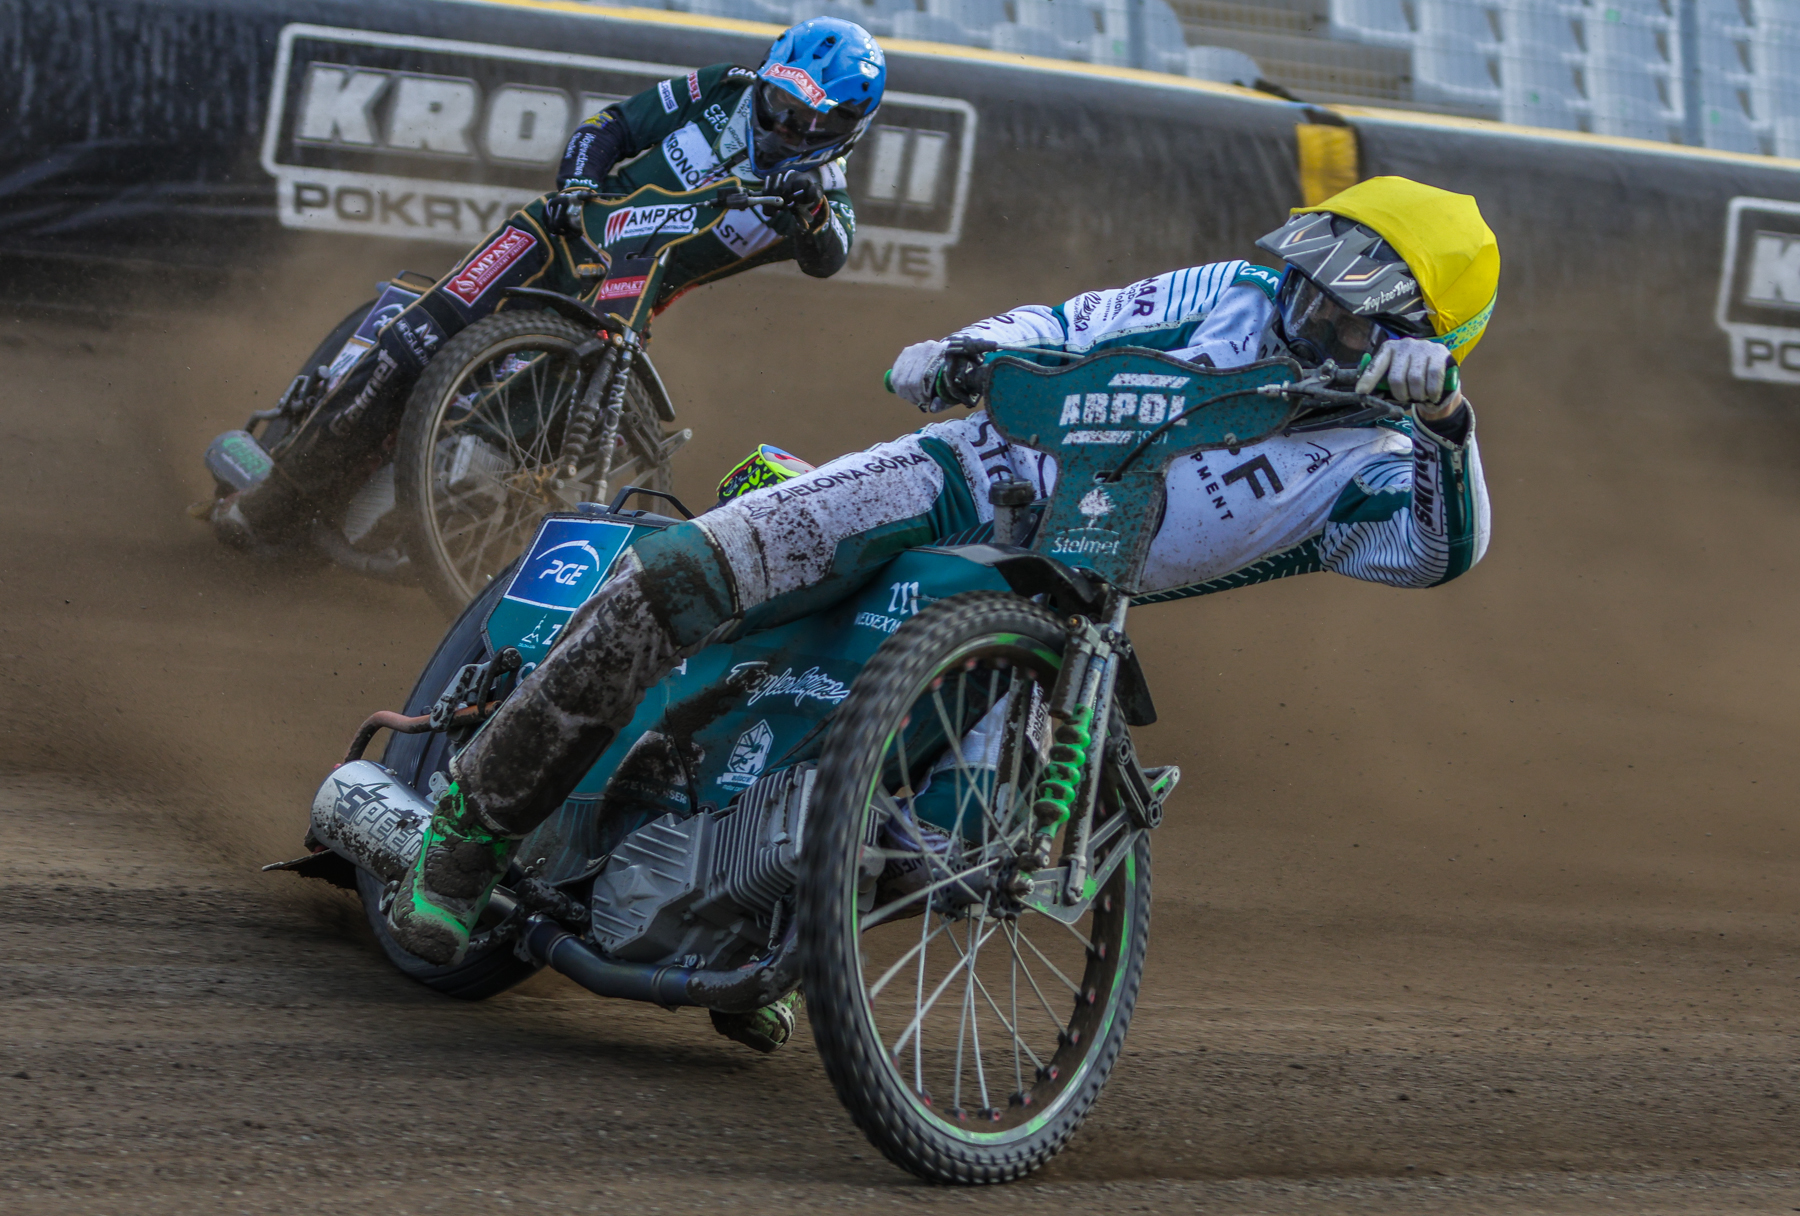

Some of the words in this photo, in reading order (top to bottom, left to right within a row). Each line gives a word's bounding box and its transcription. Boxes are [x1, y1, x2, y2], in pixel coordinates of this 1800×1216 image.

[780, 67, 824, 101] IMPAKT
[297, 66, 606, 164] KRO
[294, 181, 516, 234] POKRY
[626, 206, 694, 228] AMPRO
[467, 230, 523, 281] IMPAKT
[608, 280, 647, 293] IMPAKT
[1058, 392, 1189, 427] ARPOL
[767, 469, 870, 503] ZIELONA
[865, 449, 931, 476] GÓRA
[538, 559, 590, 586] PGE
